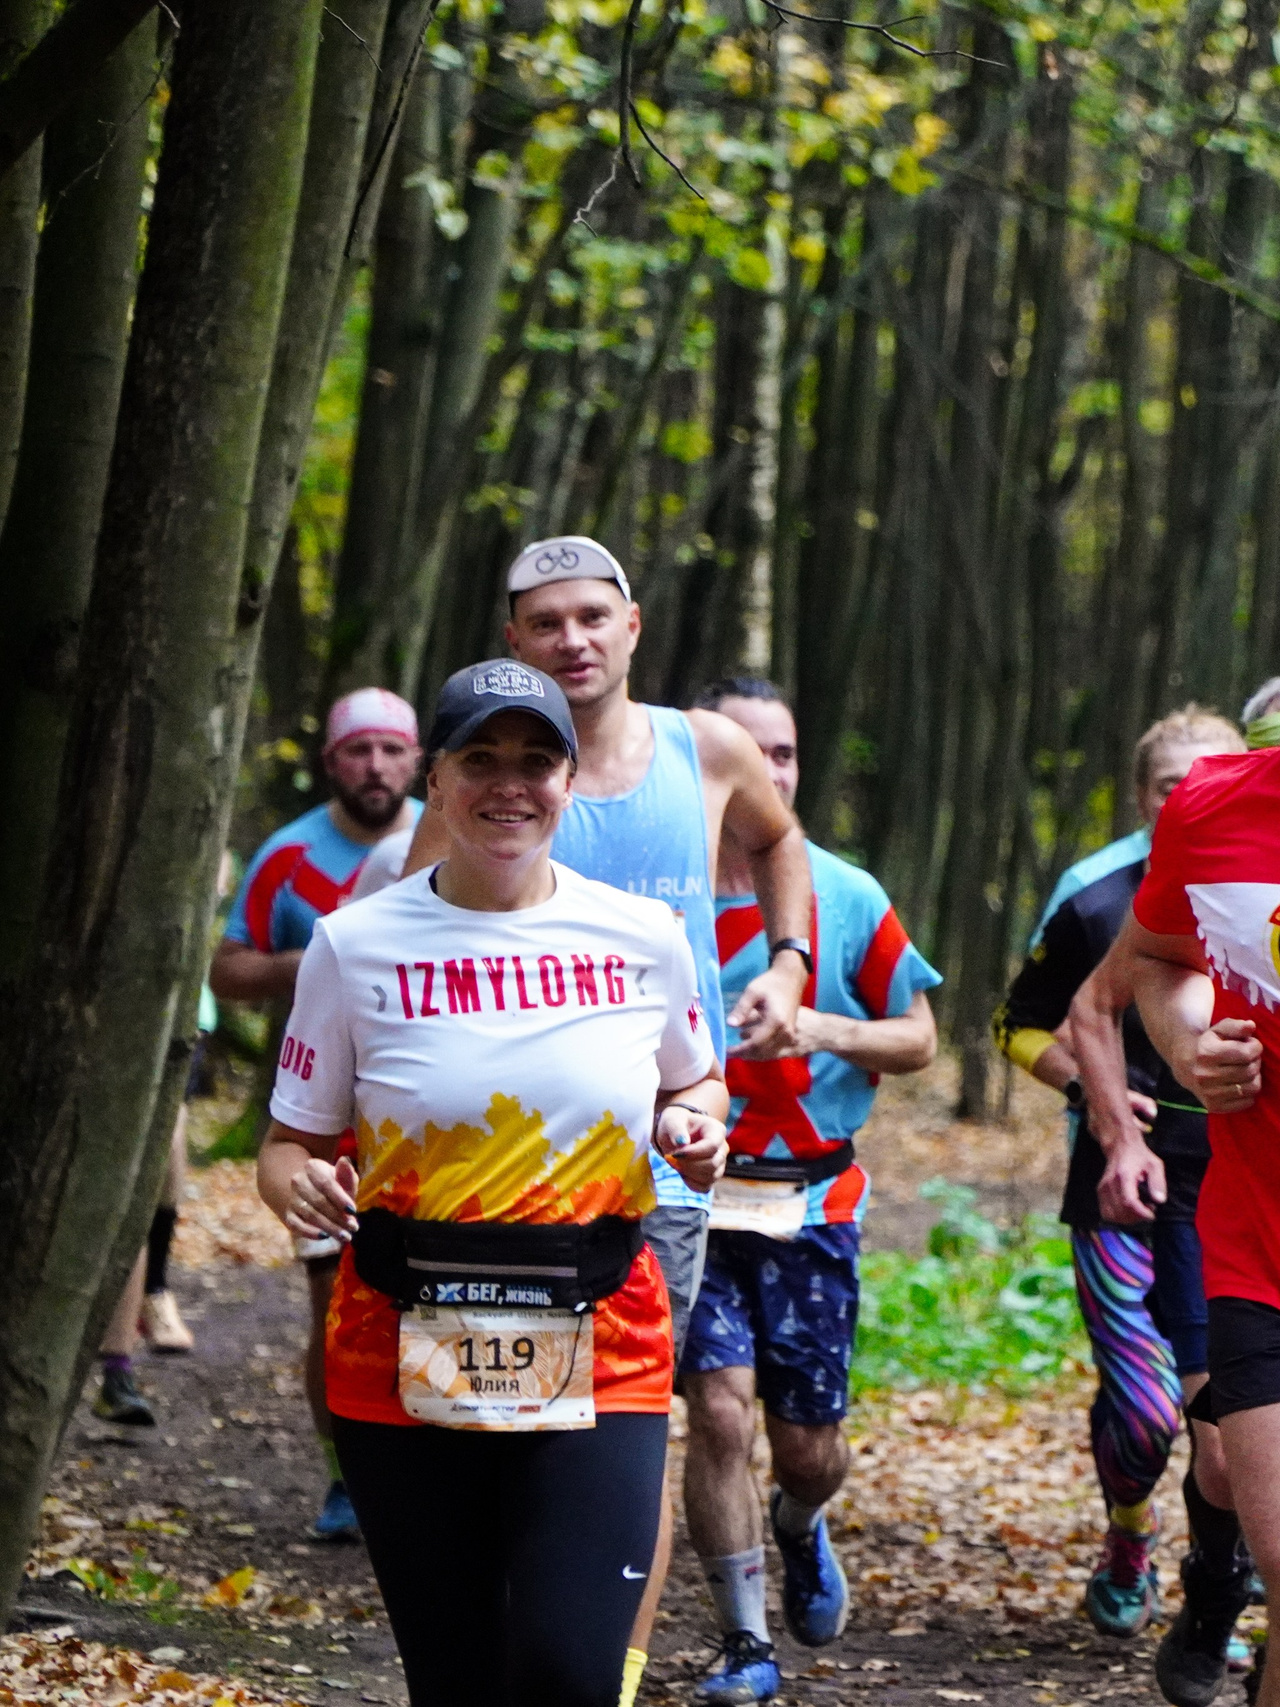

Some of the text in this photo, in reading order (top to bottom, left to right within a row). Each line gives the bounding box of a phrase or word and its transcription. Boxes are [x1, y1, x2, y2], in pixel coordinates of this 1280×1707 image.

[656, 876, 703, 897] RUN
[395, 953, 626, 1020] IZMYLONG
[280, 1036, 316, 1081] ONG
[467, 1283, 552, 1306] БЕГ, ЖИЗНЬ
[458, 1336, 536, 1372] 119
[470, 1377, 520, 1393] Юлия
